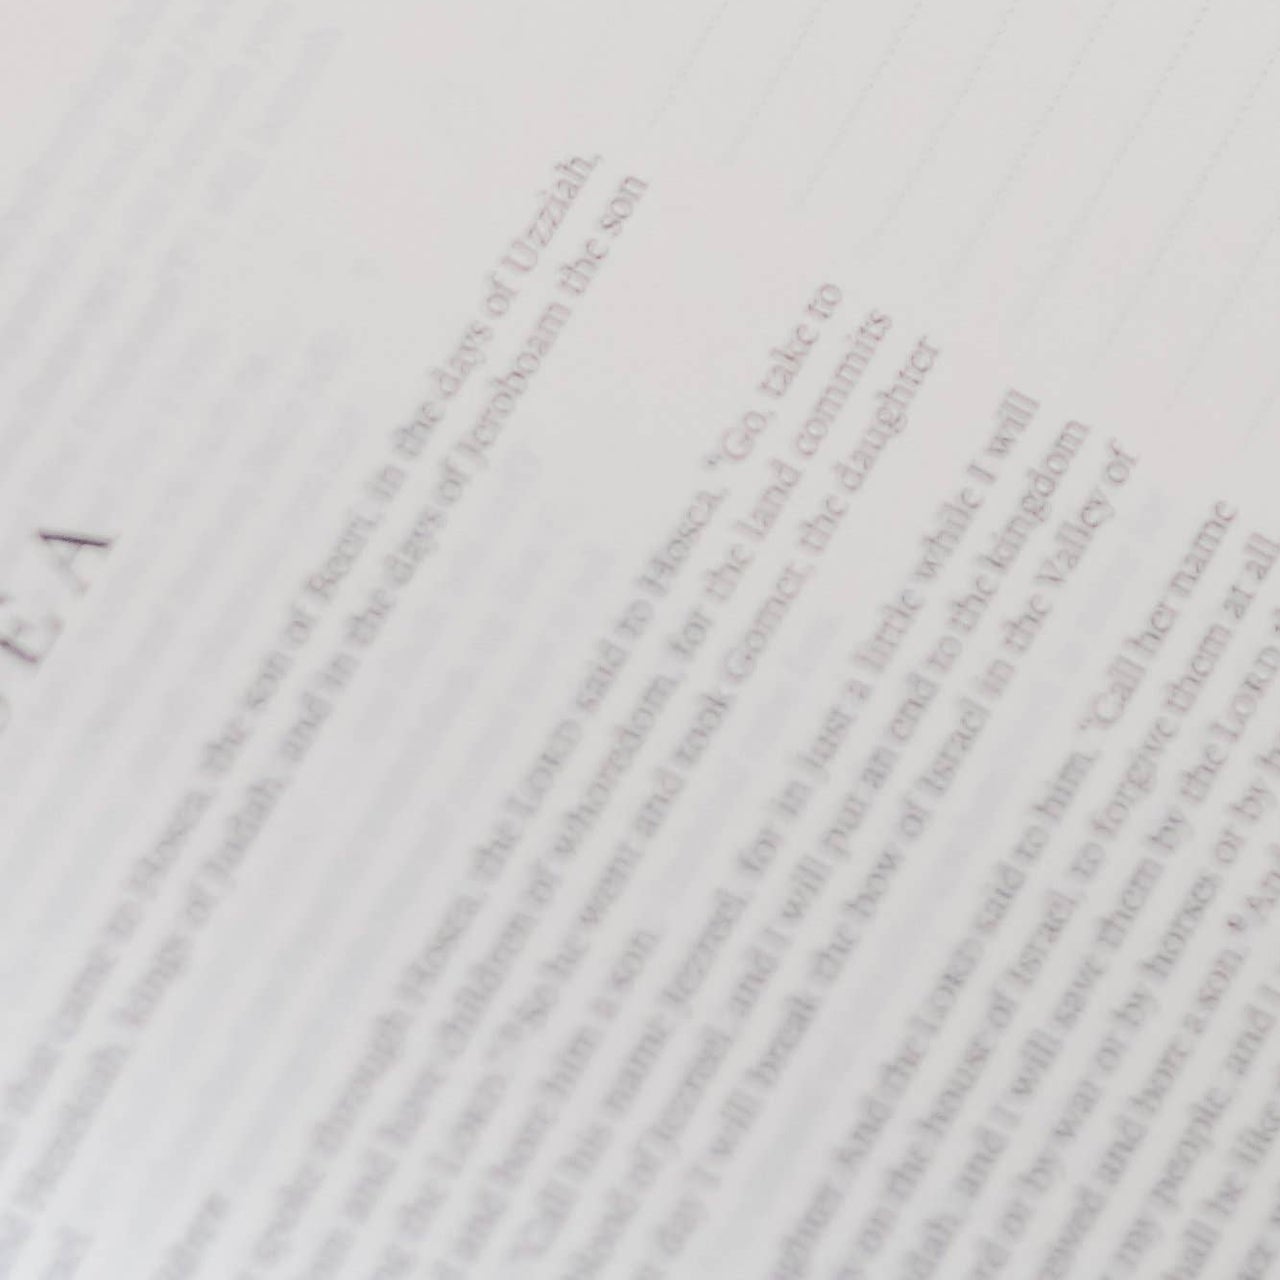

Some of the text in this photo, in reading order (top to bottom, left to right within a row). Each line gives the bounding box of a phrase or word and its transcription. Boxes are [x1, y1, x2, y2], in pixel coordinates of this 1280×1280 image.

[554, 234, 609, 297] the
[595, 173, 648, 238] son
[754, 320, 820, 401] take
[803, 280, 844, 323] to
[789, 307, 893, 461] commits
[830, 332, 943, 496] daughter
[980, 387, 1040, 461] will
[976, 416, 1092, 577] kingdom
[1031, 485, 1116, 593] Valley
[1096, 437, 1139, 488] of
[1166, 498, 1238, 599] name
[1219, 580, 1256, 620] at
